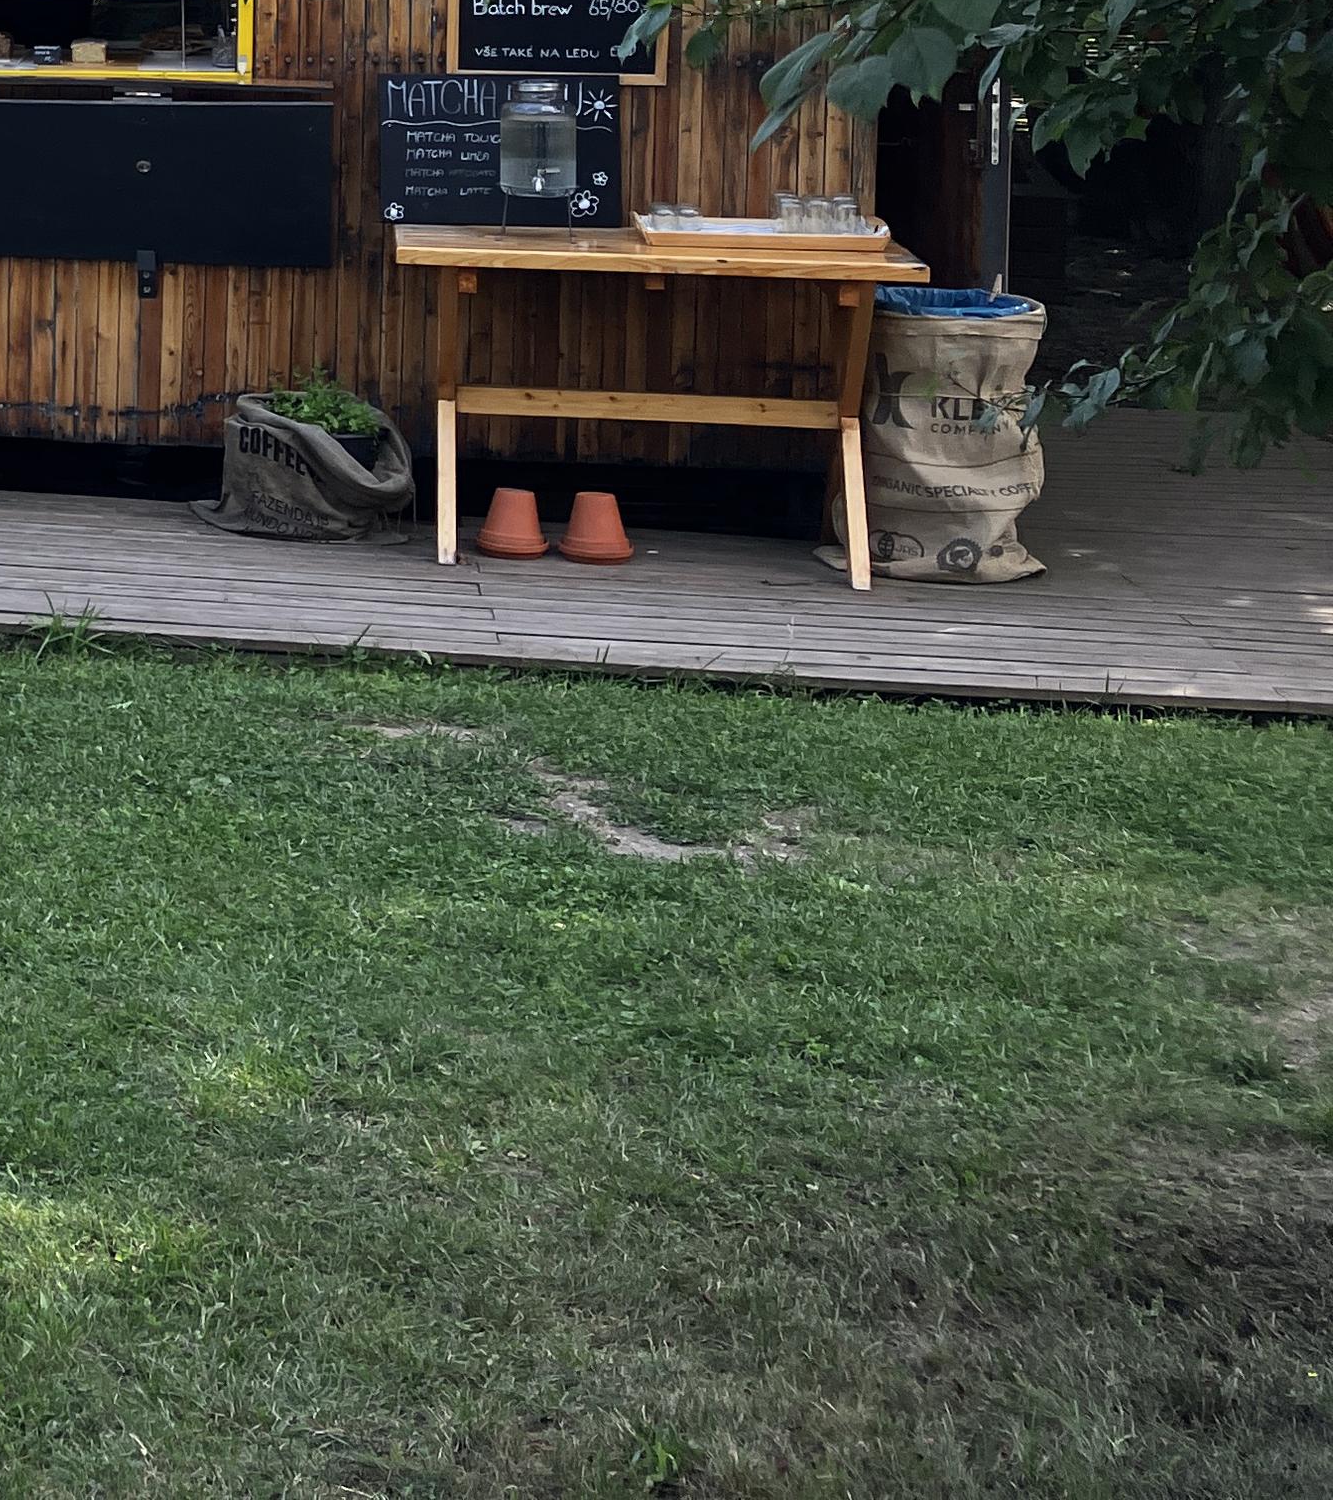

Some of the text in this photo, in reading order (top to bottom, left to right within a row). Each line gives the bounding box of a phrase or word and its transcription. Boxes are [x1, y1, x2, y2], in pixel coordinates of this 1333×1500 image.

[475, 45, 599, 59] VŠE TAKÉ NA LEDU
[387, 79, 497, 118] MATCHA
[406, 130, 456, 144] MATCHA
[406, 148, 453, 161] MATCHA
[405, 186, 449, 197] MATCHA
[252, 491, 313, 526] FAZENDA
